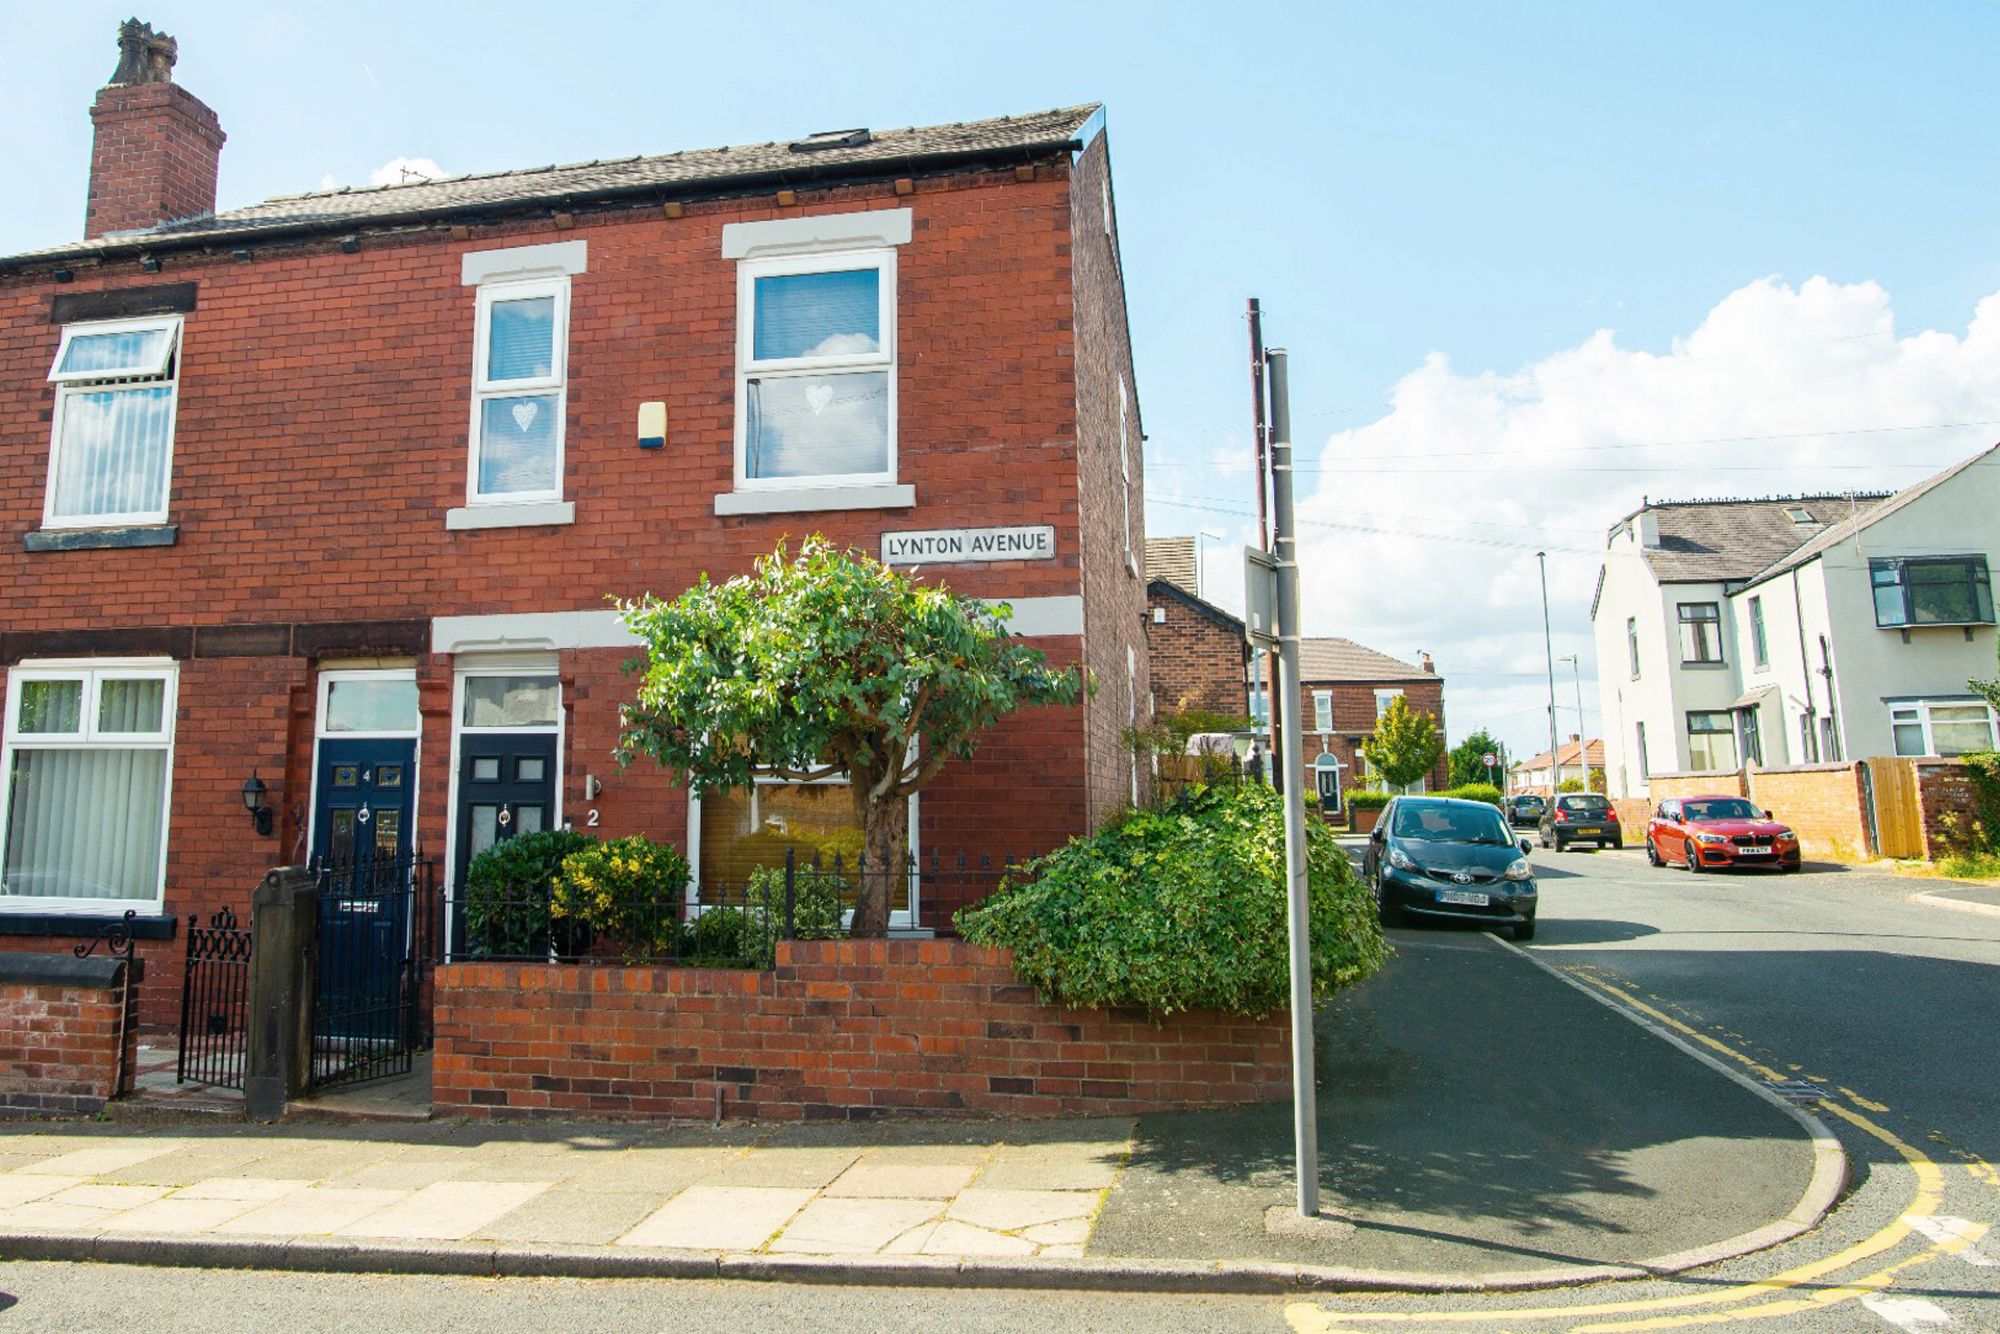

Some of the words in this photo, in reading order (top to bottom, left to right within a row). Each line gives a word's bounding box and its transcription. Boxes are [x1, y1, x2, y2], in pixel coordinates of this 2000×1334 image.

[889, 537, 962, 555] LYNTON
[971, 533, 1046, 552] AVENUE
[363, 769, 370, 781] 4
[587, 809, 599, 826] 2
